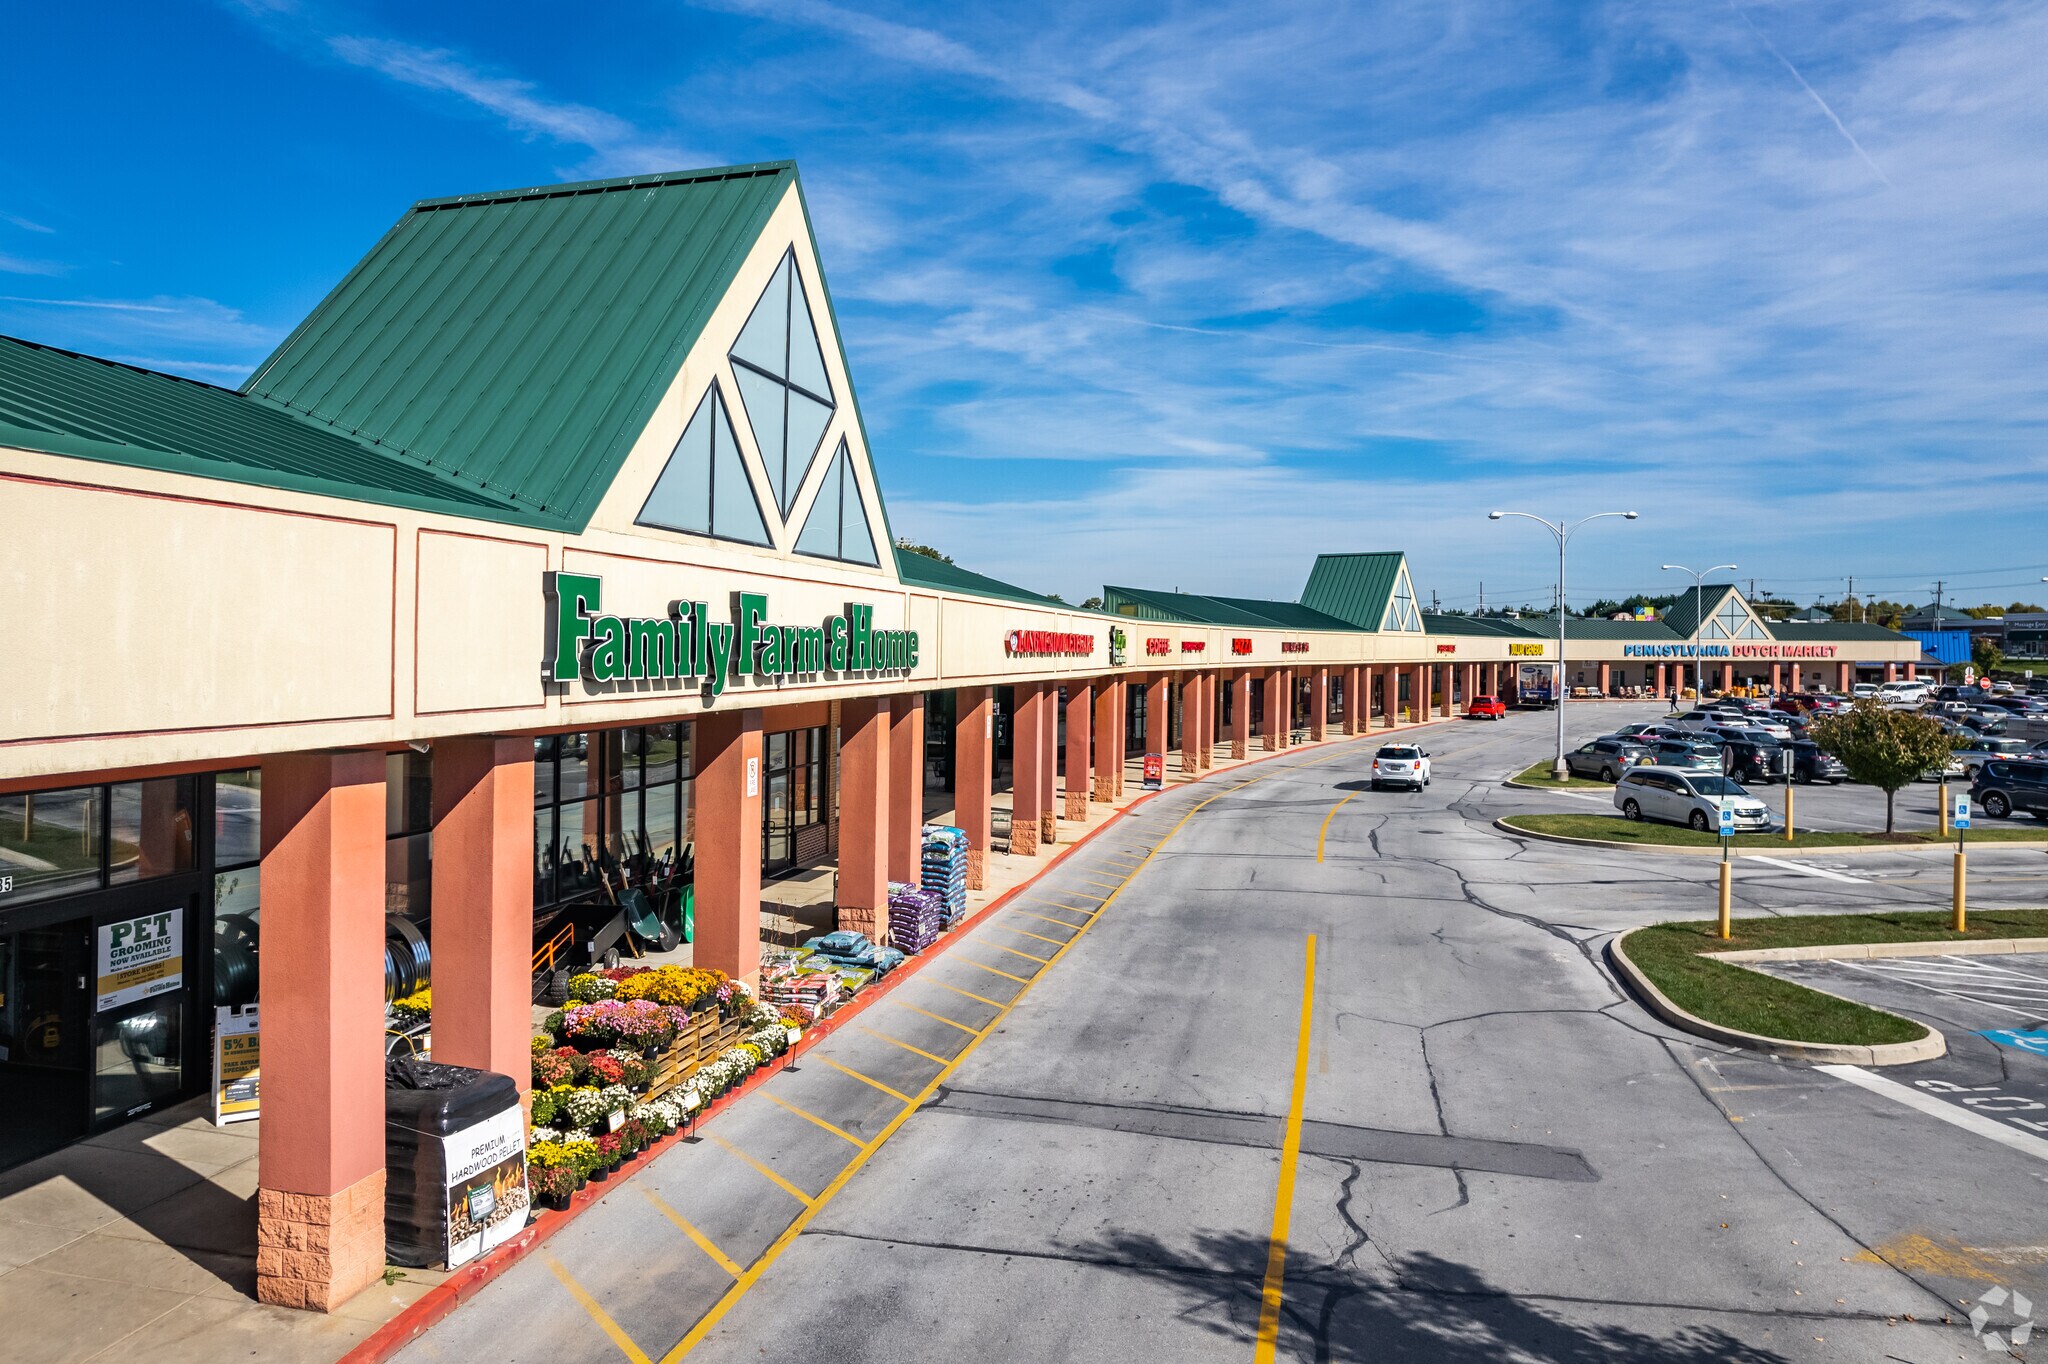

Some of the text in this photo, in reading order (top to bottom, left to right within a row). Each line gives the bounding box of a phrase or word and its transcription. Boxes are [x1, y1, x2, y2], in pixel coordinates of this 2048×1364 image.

[545, 570, 919, 697] Family Farm & Home
[1624, 645, 1838, 657] PENNSYLVANIA DUTCH MARKET
[110, 912, 172, 949] PET
[110, 936, 171, 959] GROOMING
[110, 946, 171, 967] NOW AVAILABLE
[119, 968, 141, 979] STORE
[141, 962, 162, 973] HOURS
[224, 1038, 244, 1050] 5%
[471, 1134, 506, 1160] PREMIUM
[451, 1138, 521, 1183] HARDWOOD PELLET
